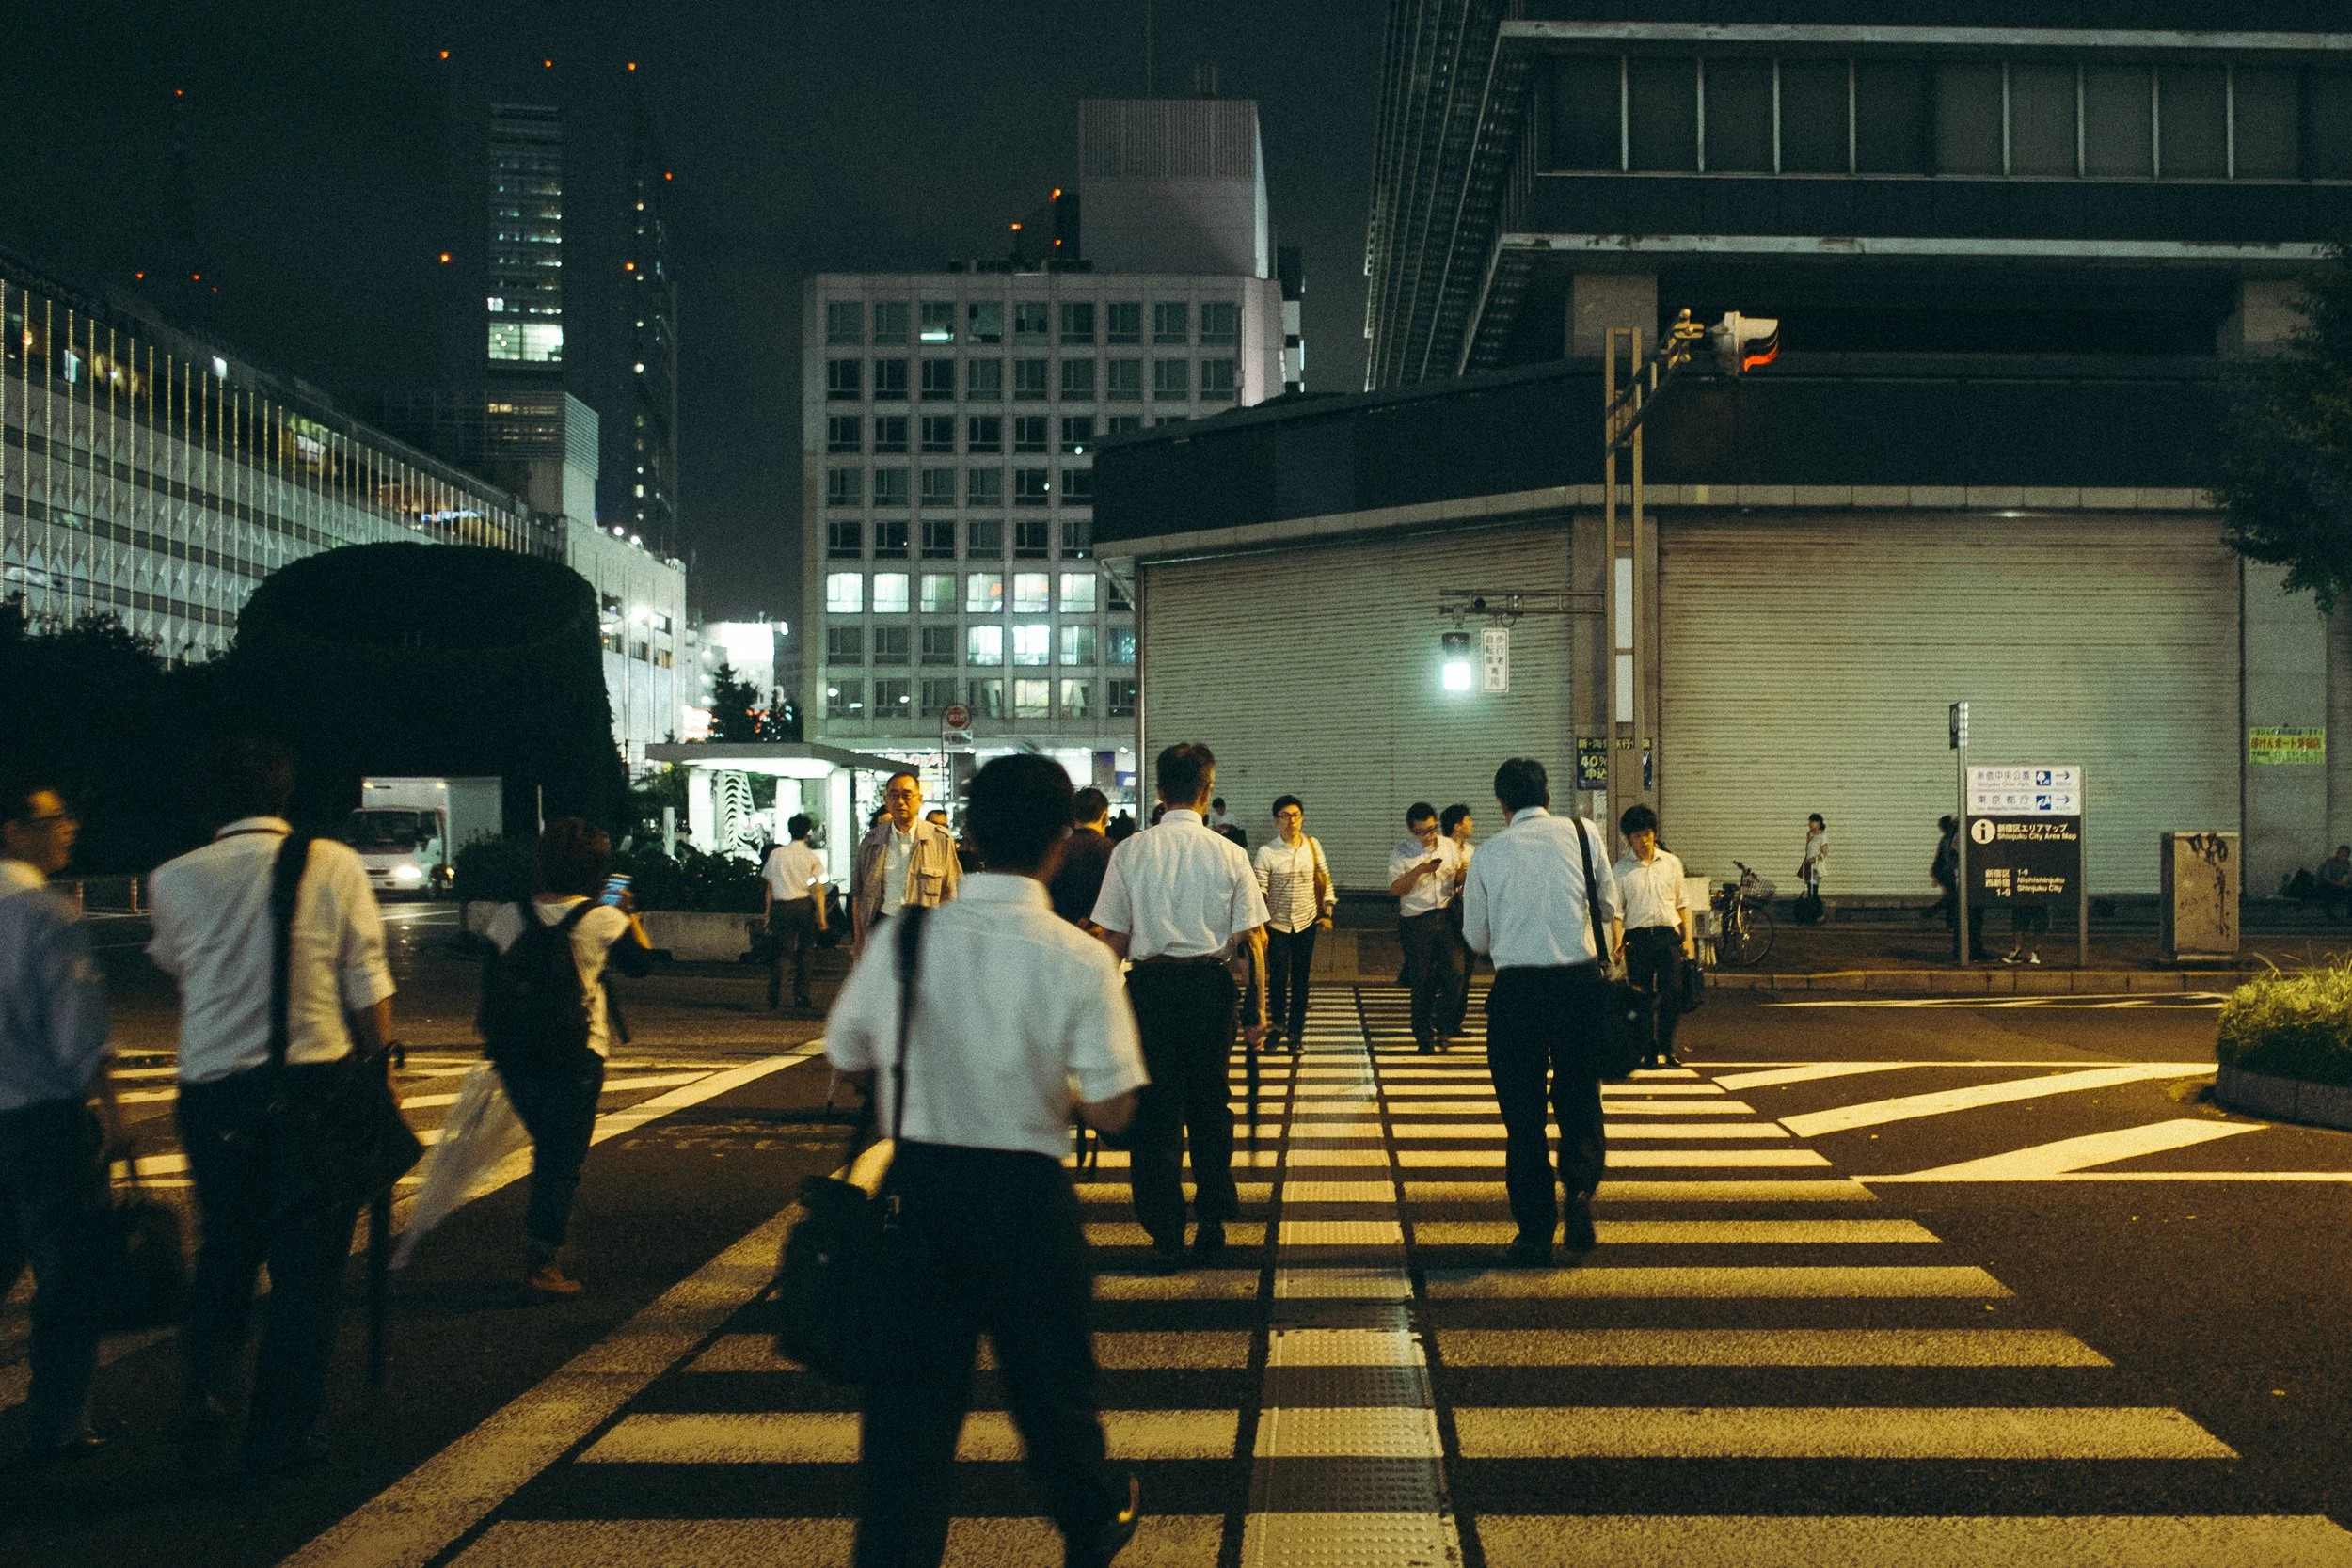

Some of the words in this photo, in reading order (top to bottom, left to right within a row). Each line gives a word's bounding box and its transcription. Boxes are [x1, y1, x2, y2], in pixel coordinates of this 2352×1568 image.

[1978, 771, 2029, 780] 新宿中央公園
[1996, 823, 2068, 832] 新宿区エリアマップ
[1996, 832, 2027, 841] Shinjuku
[2029, 832, 2043, 841] City
[2061, 832, 2077, 841] Map
